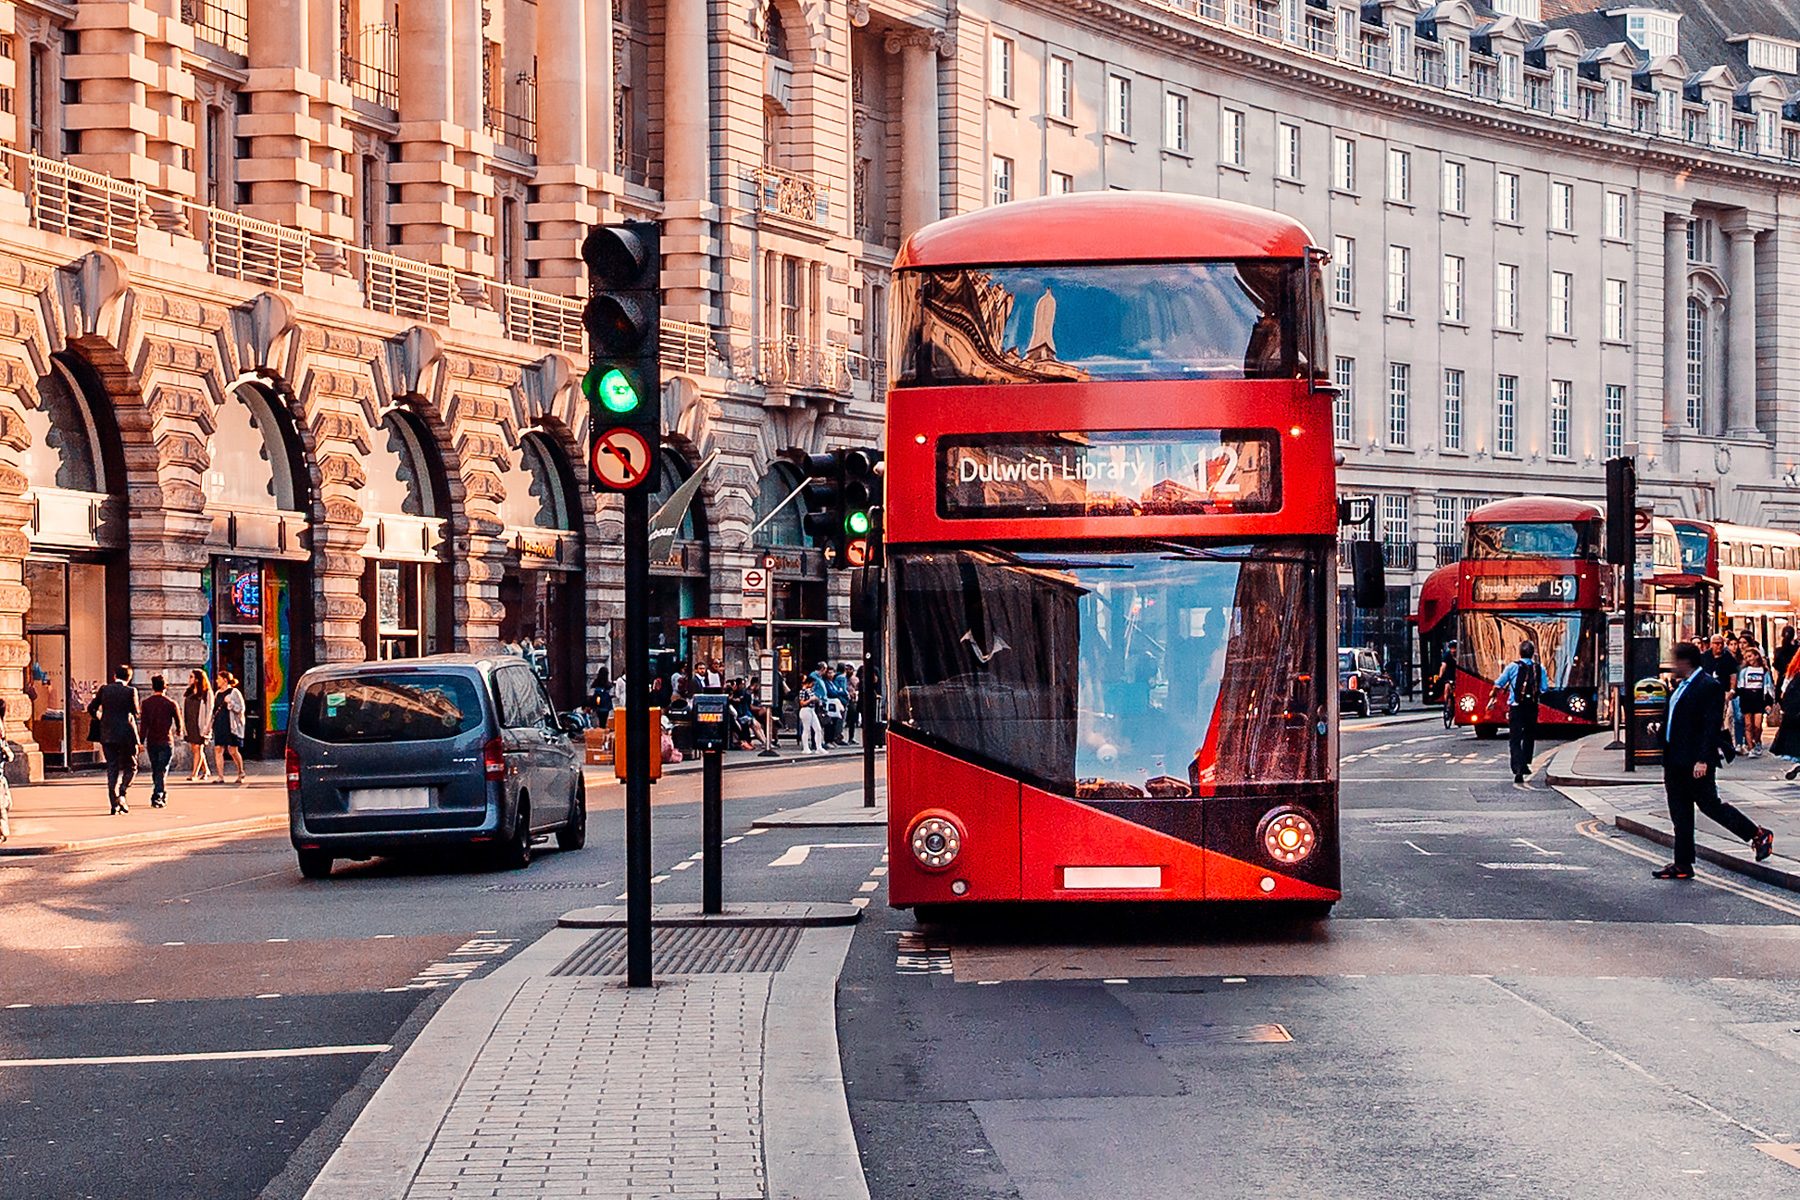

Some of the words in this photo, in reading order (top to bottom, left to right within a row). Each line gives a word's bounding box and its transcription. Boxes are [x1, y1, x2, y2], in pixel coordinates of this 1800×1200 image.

[960, 457, 1053, 482] Dulwich
[1062, 455, 1146, 486] Library
[1195, 446, 1240, 493] 12
[1516, 584, 1538, 593] Station
[1550, 580, 1572, 596] 159
